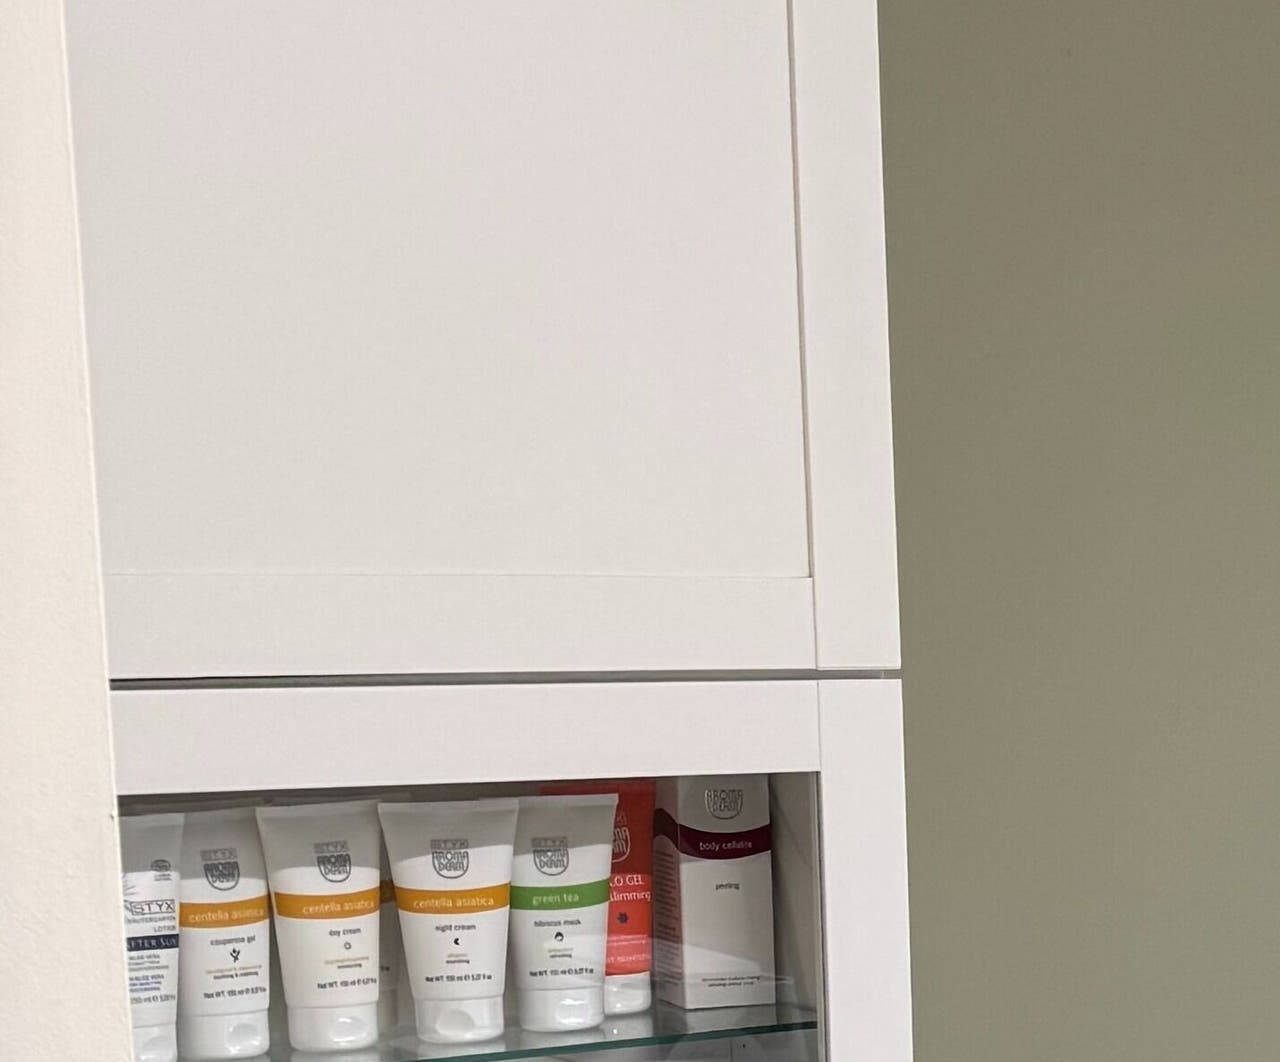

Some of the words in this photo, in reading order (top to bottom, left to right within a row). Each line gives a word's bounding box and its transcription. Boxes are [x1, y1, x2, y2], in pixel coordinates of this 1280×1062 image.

[700, 841, 719, 851] body
[532, 893, 561, 905] green
[563, 890, 580, 902] tea
[133, 901, 175, 914] STYX
